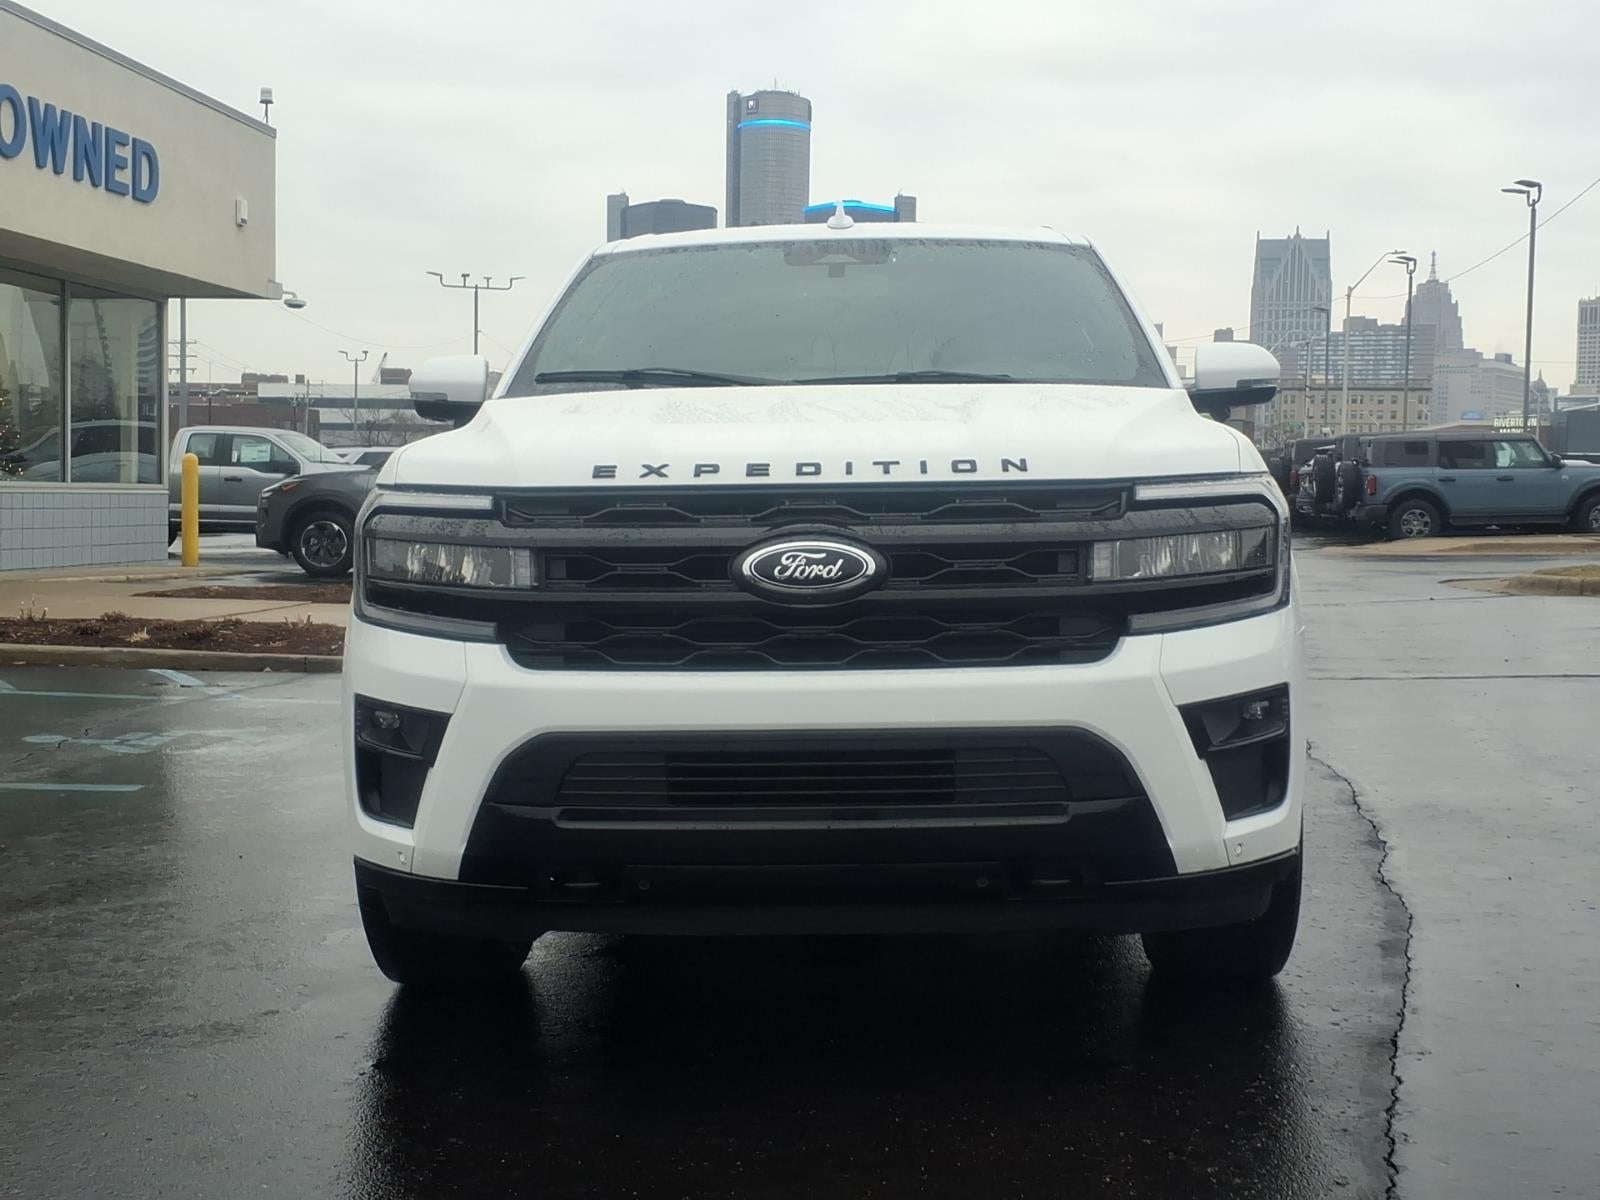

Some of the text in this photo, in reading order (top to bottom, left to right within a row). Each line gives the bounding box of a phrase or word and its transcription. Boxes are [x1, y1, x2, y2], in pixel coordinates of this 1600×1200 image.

[0, 84, 160, 203] OWNED
[592, 458, 1029, 479] EXPEDITION
[774, 552, 844, 579] Ford
